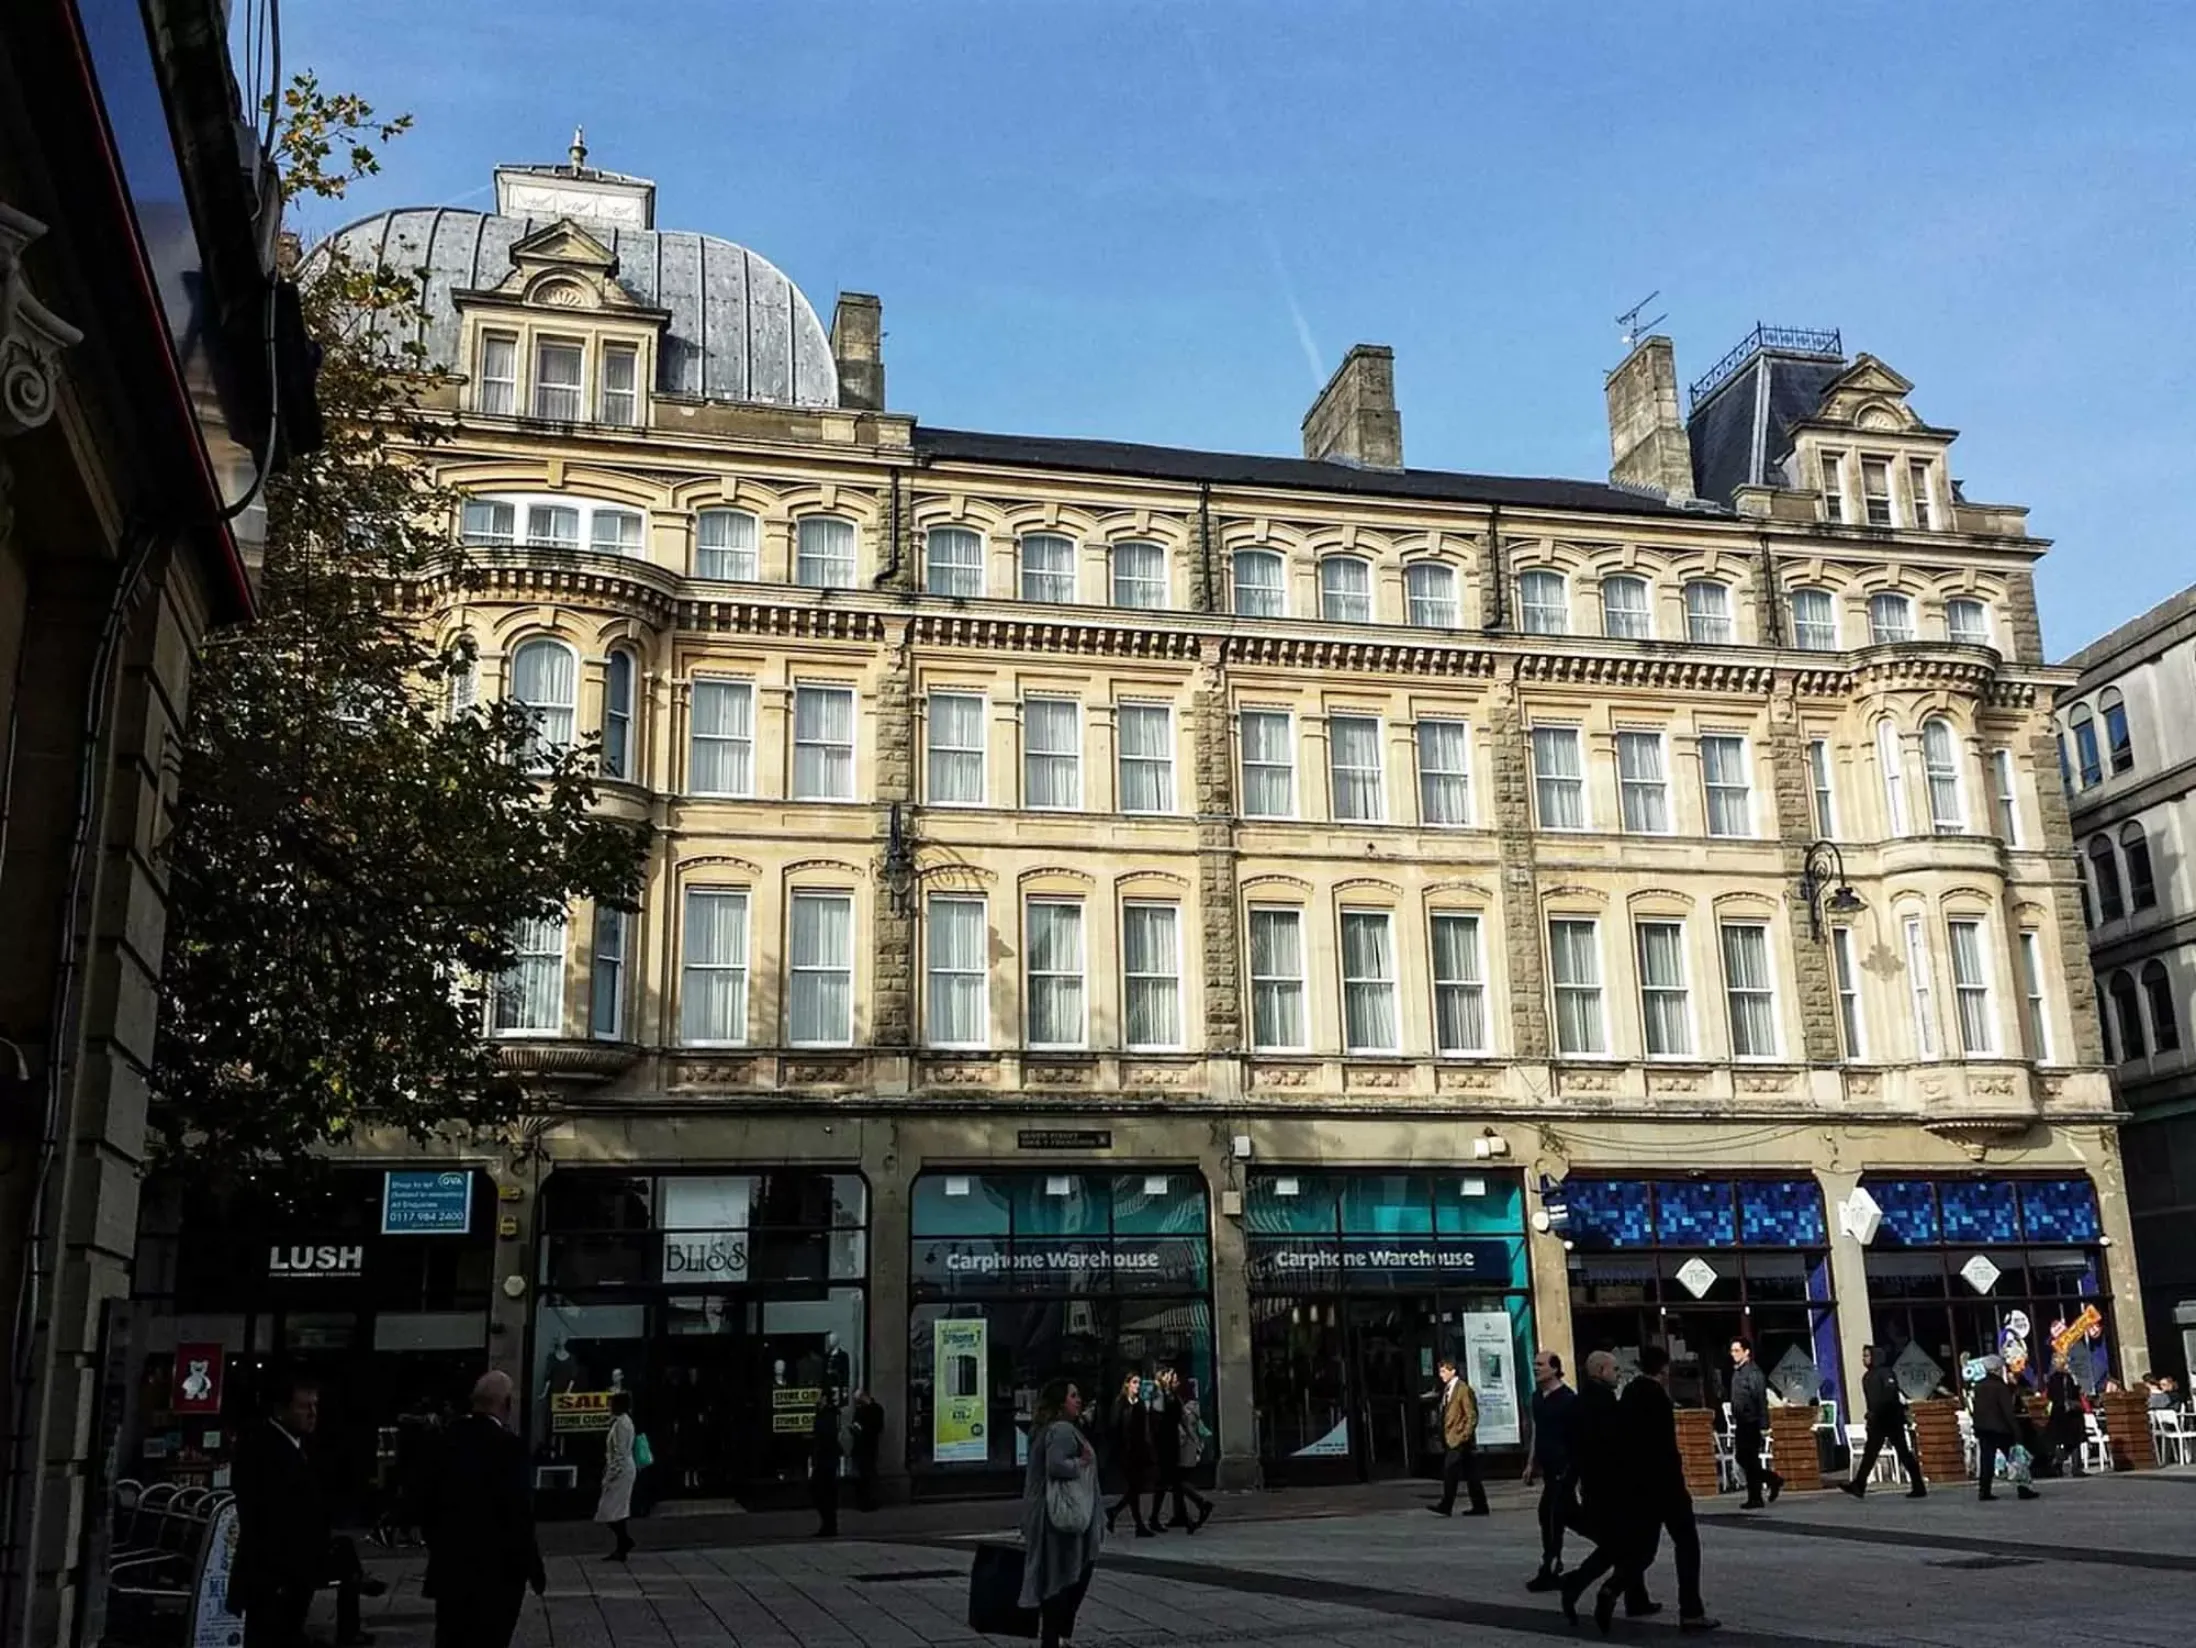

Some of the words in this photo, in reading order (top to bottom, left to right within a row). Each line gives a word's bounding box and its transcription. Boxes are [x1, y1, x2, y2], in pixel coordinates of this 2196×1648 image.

[269, 1245, 363, 1270] LUSH
[667, 1241, 748, 1272] BLISS
[946, 1251, 1045, 1274] Carphone
[1046, 1250, 1160, 1269] Warehouse
[1369, 1248, 1475, 1267] Warehouse
[558, 1395, 612, 1409] SAL
